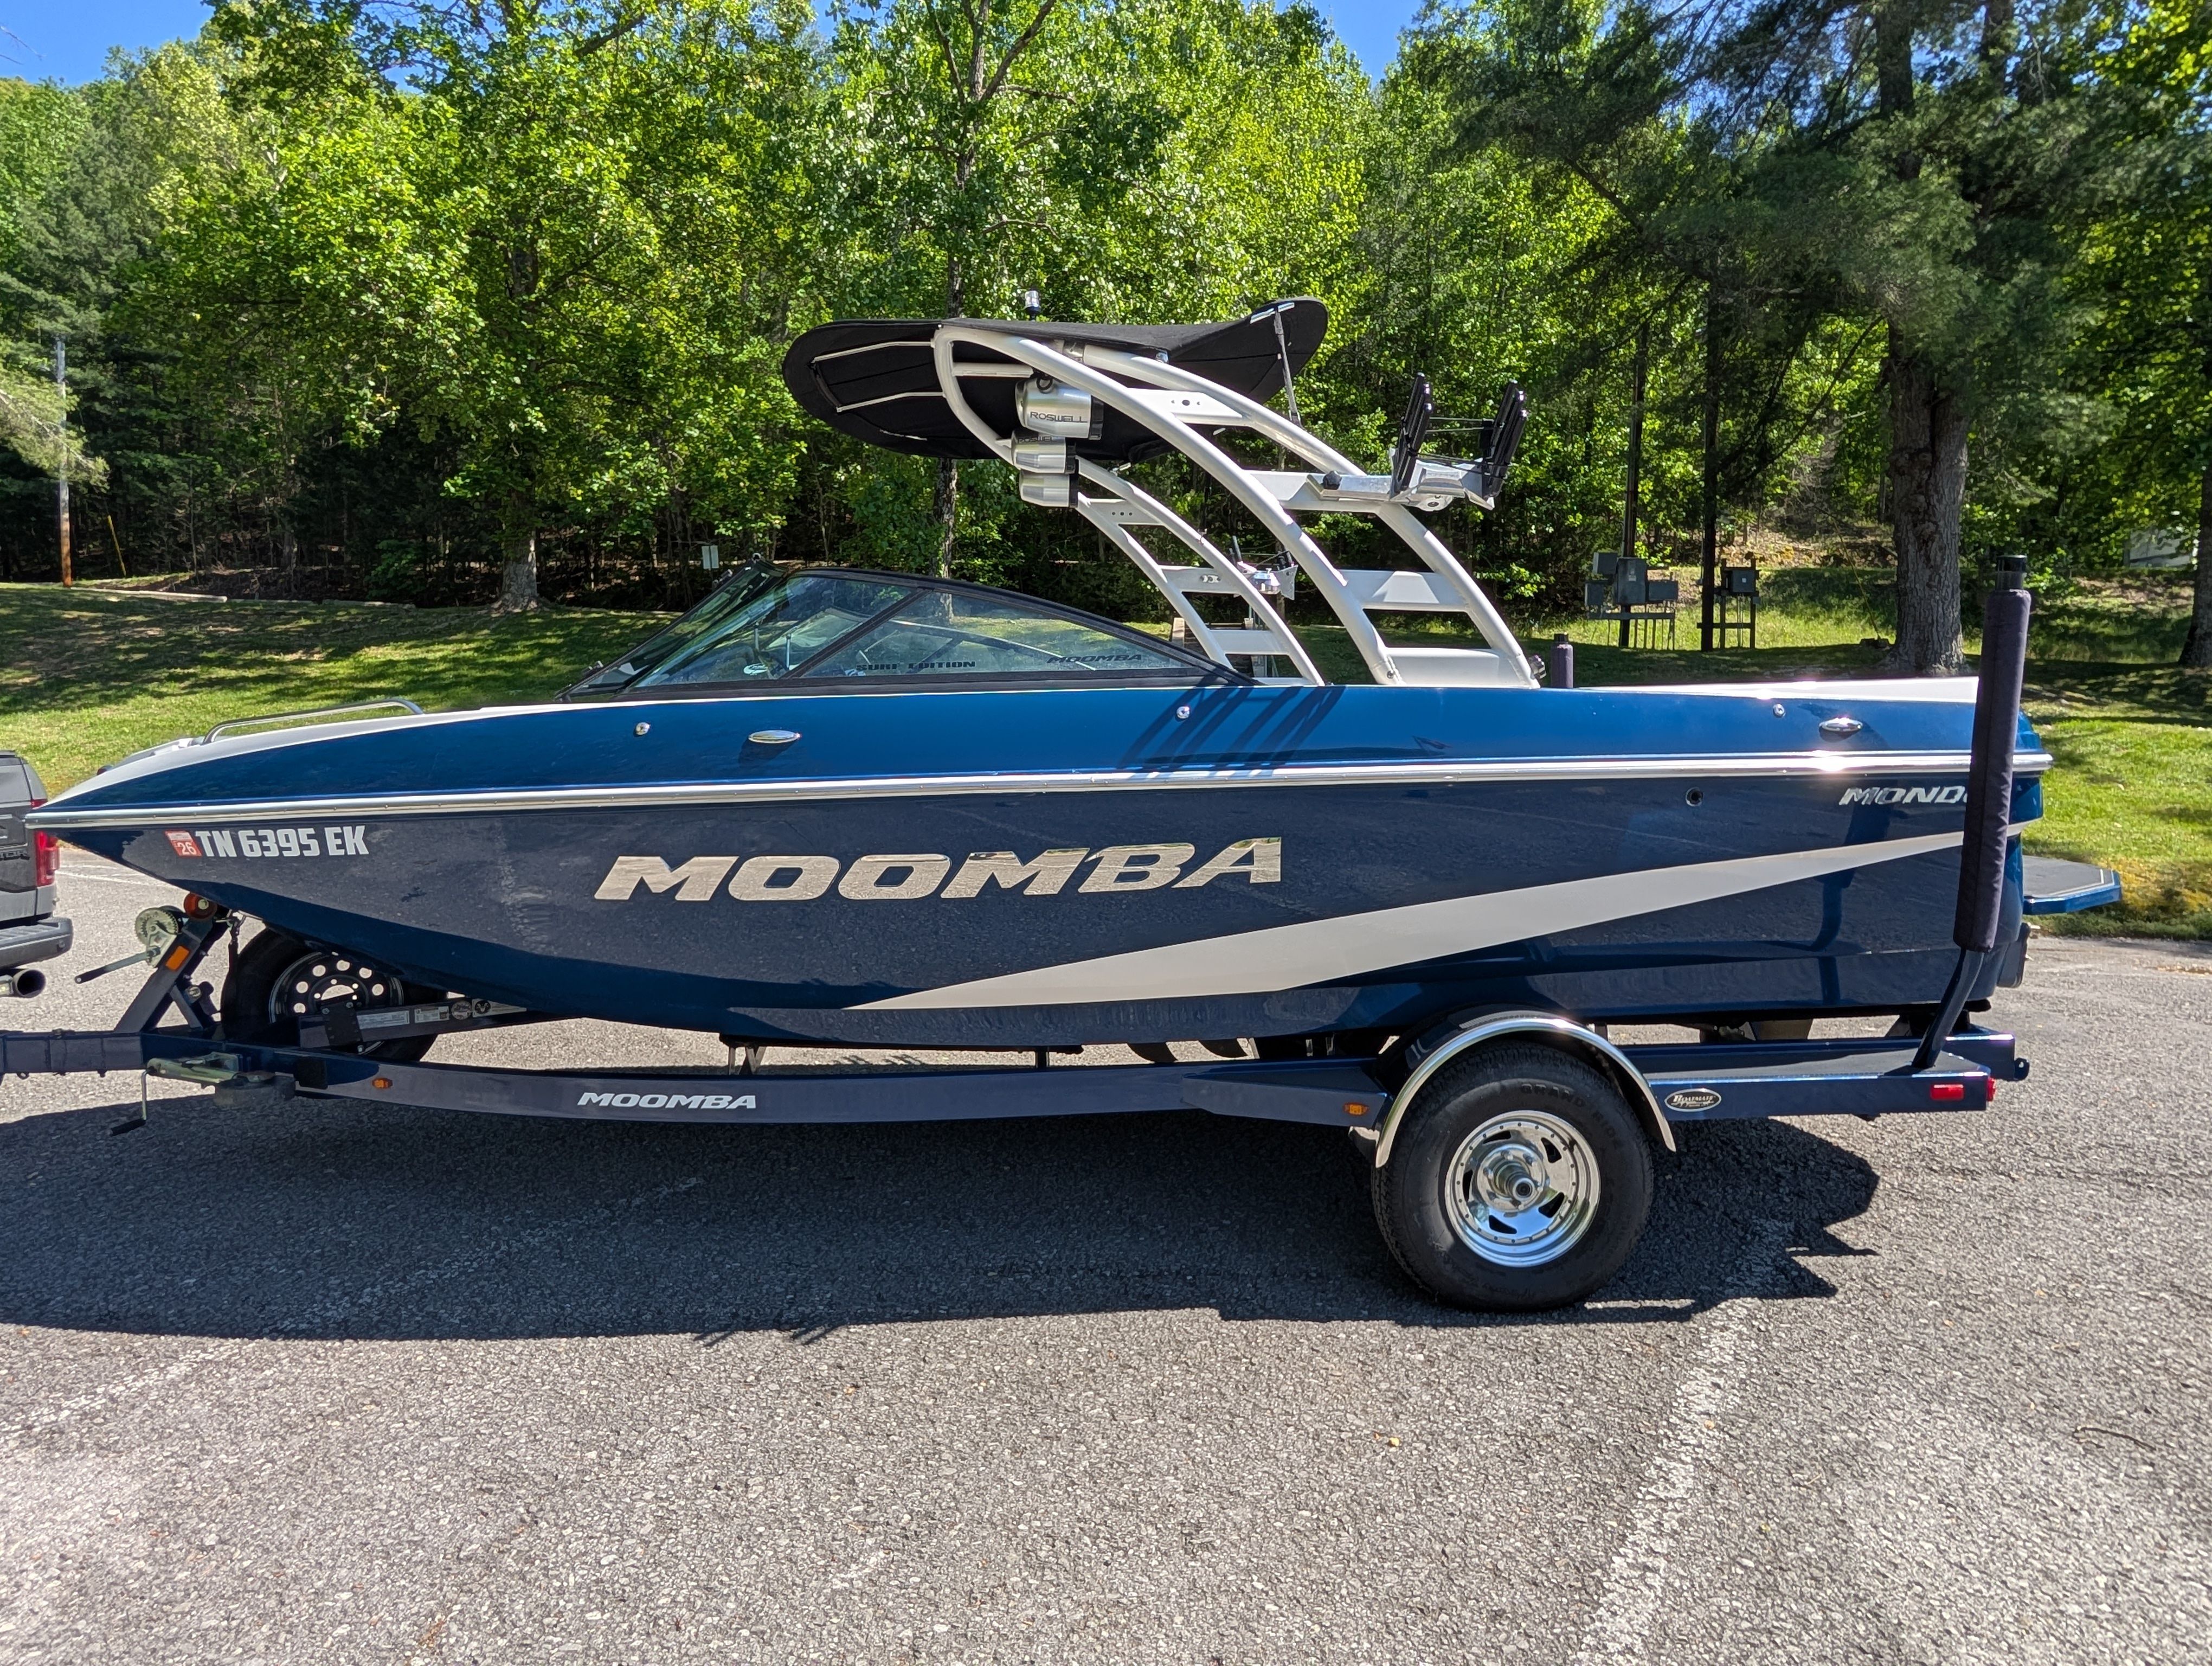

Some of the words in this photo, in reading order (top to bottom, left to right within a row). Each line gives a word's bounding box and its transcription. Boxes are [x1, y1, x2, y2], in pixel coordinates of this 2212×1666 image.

[1030, 412, 1088, 423] ROSWELL
[1018, 435, 1058, 444] ROSWEL
[1047, 654, 1141, 664] MOOMBA
[1838, 786, 1967, 805] MOND
[177, 842, 197, 855] 26
[195, 830, 237, 857] TN
[237, 828, 320, 857] 6395
[324, 825, 369, 856] EK
[594, 836, 1282, 901] MOOMBA
[577, 1092, 756, 1110] MOOMBA
